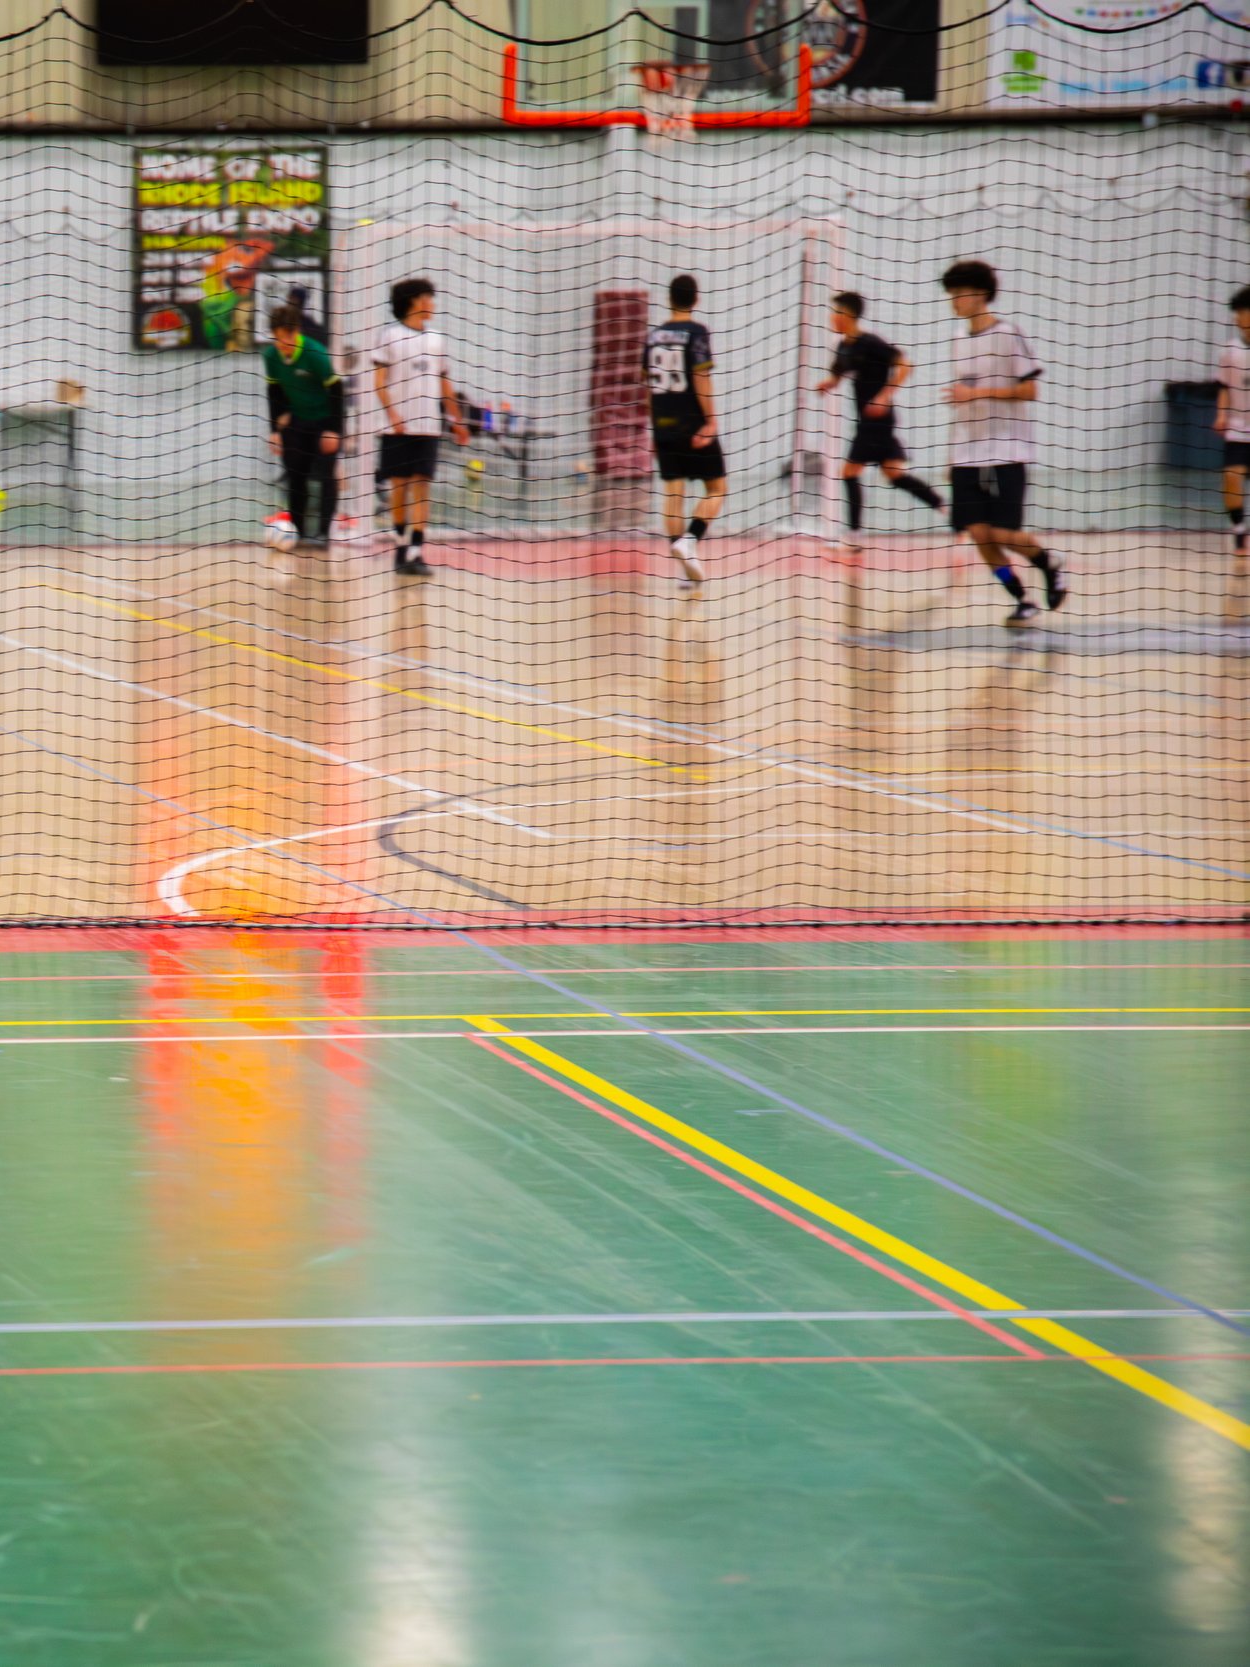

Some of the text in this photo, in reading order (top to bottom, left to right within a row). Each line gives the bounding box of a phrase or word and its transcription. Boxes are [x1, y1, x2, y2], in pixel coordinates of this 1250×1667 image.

[140, 152, 322, 181] HOME OF THE
